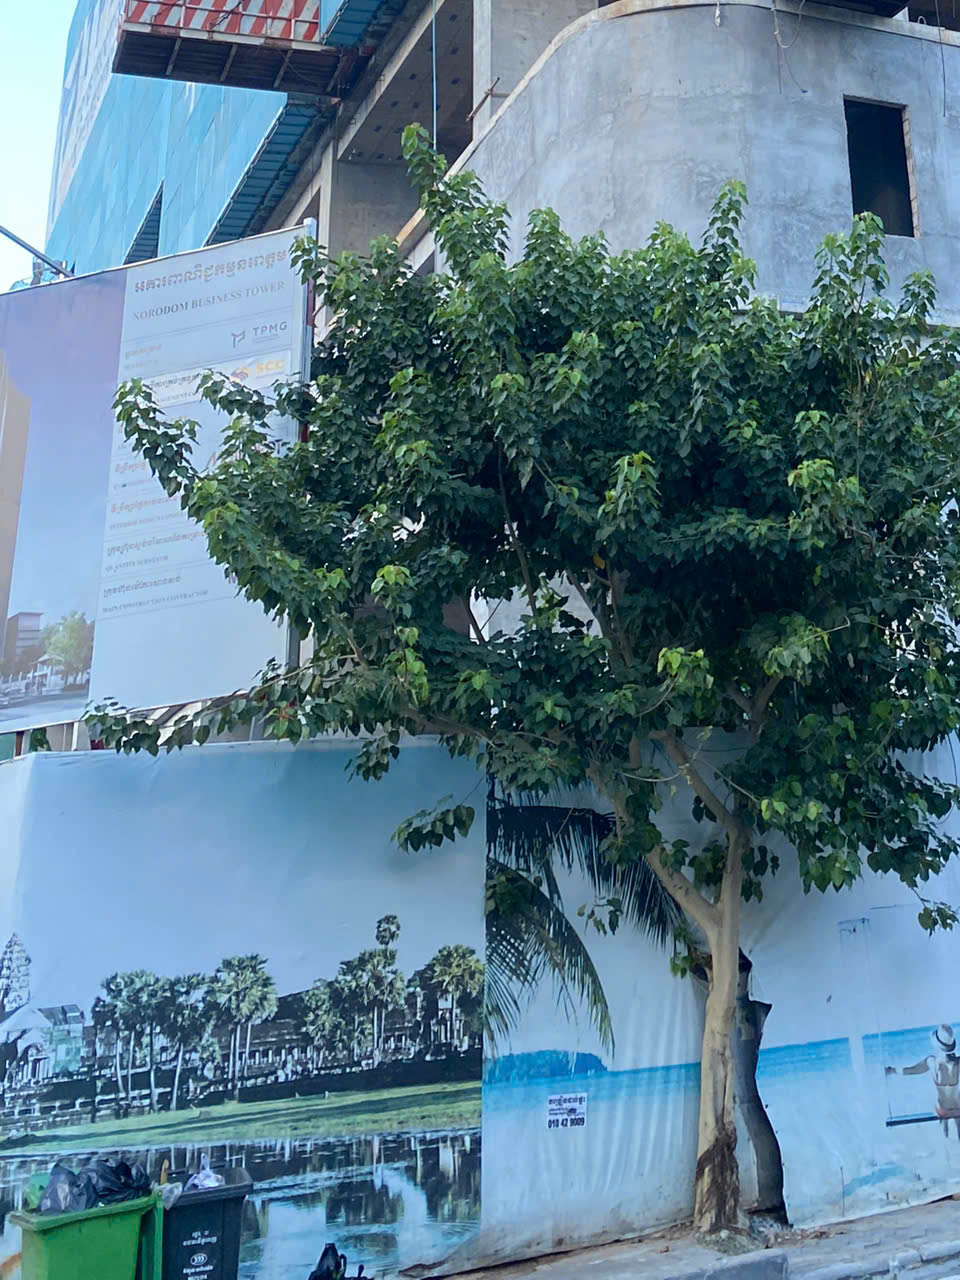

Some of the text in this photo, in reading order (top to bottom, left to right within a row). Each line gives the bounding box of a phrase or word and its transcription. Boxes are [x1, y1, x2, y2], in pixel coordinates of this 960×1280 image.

[134, 280, 286, 322] NORODOM BUSINESS TOWER
[252, 321, 288, 336] TPMG
